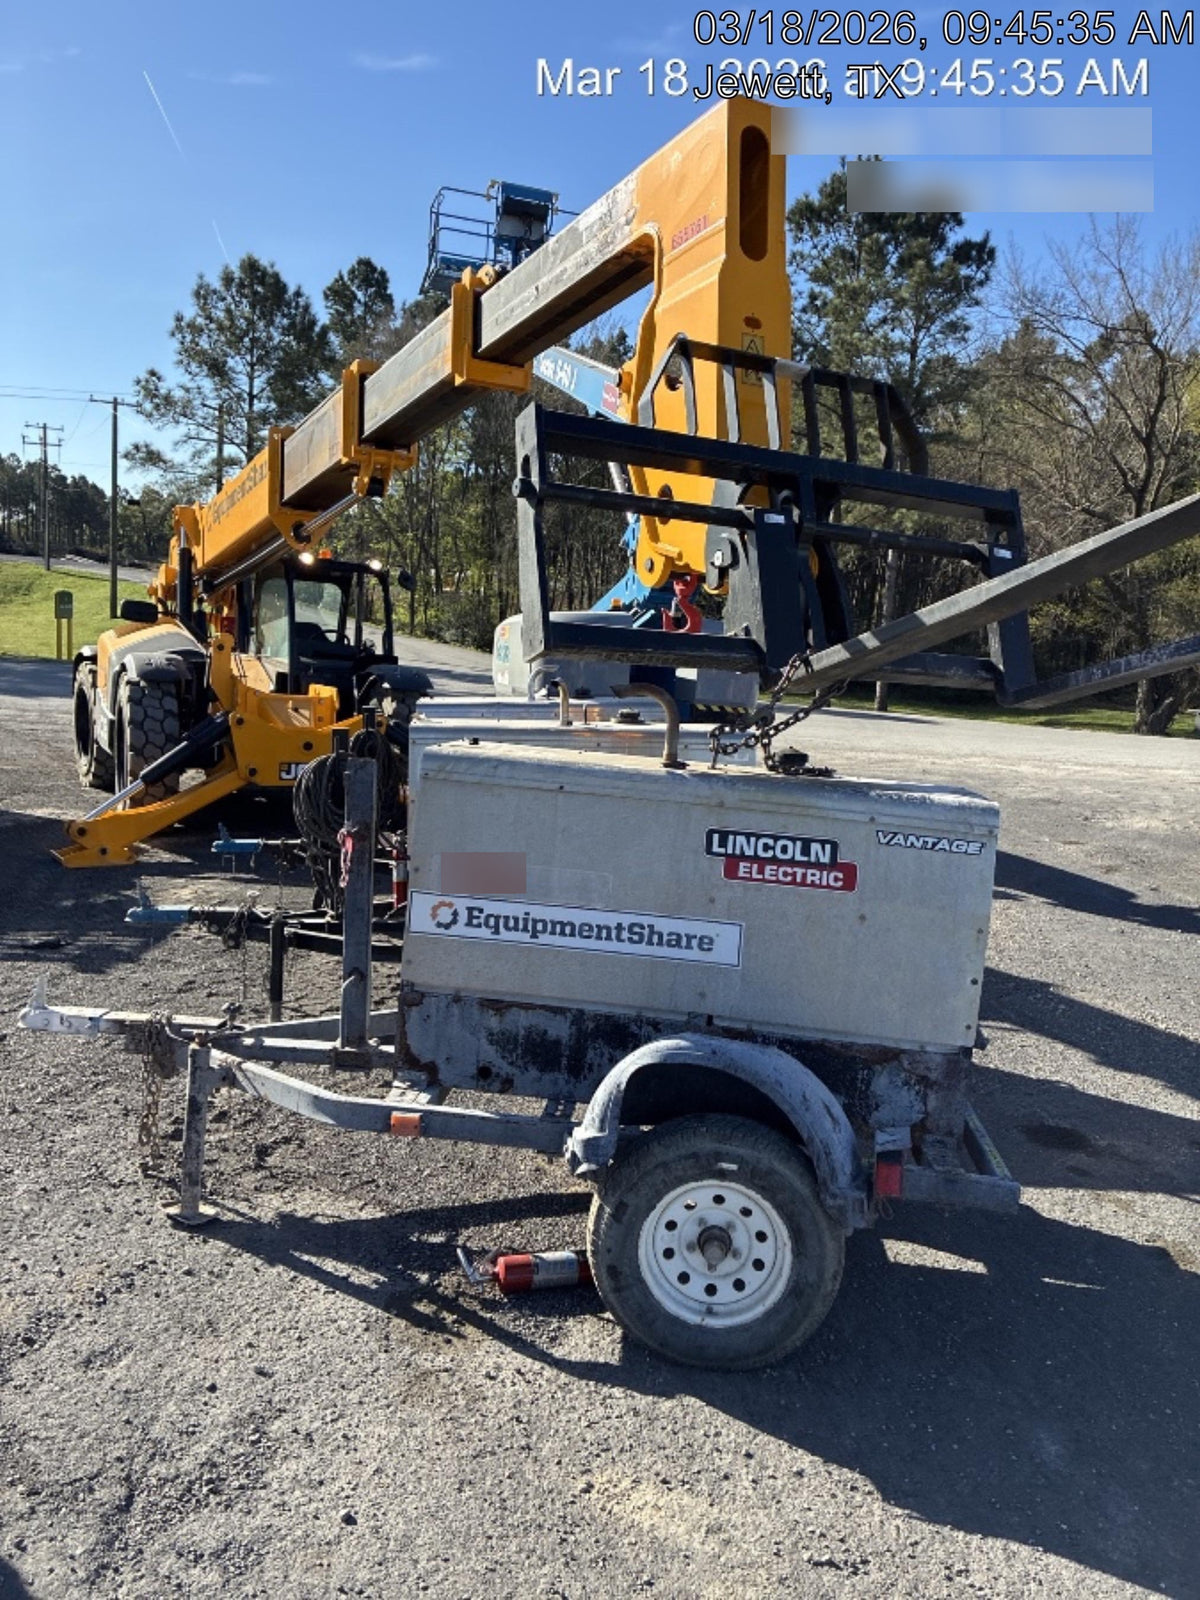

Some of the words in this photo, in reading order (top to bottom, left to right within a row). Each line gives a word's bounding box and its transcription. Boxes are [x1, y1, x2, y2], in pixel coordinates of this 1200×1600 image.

[711, 832, 832, 864] LINCOLN
[876, 830, 985, 855] VANTAGE
[738, 861, 844, 887] ELECTRIC
[464, 905, 716, 952] EquipmentShare
